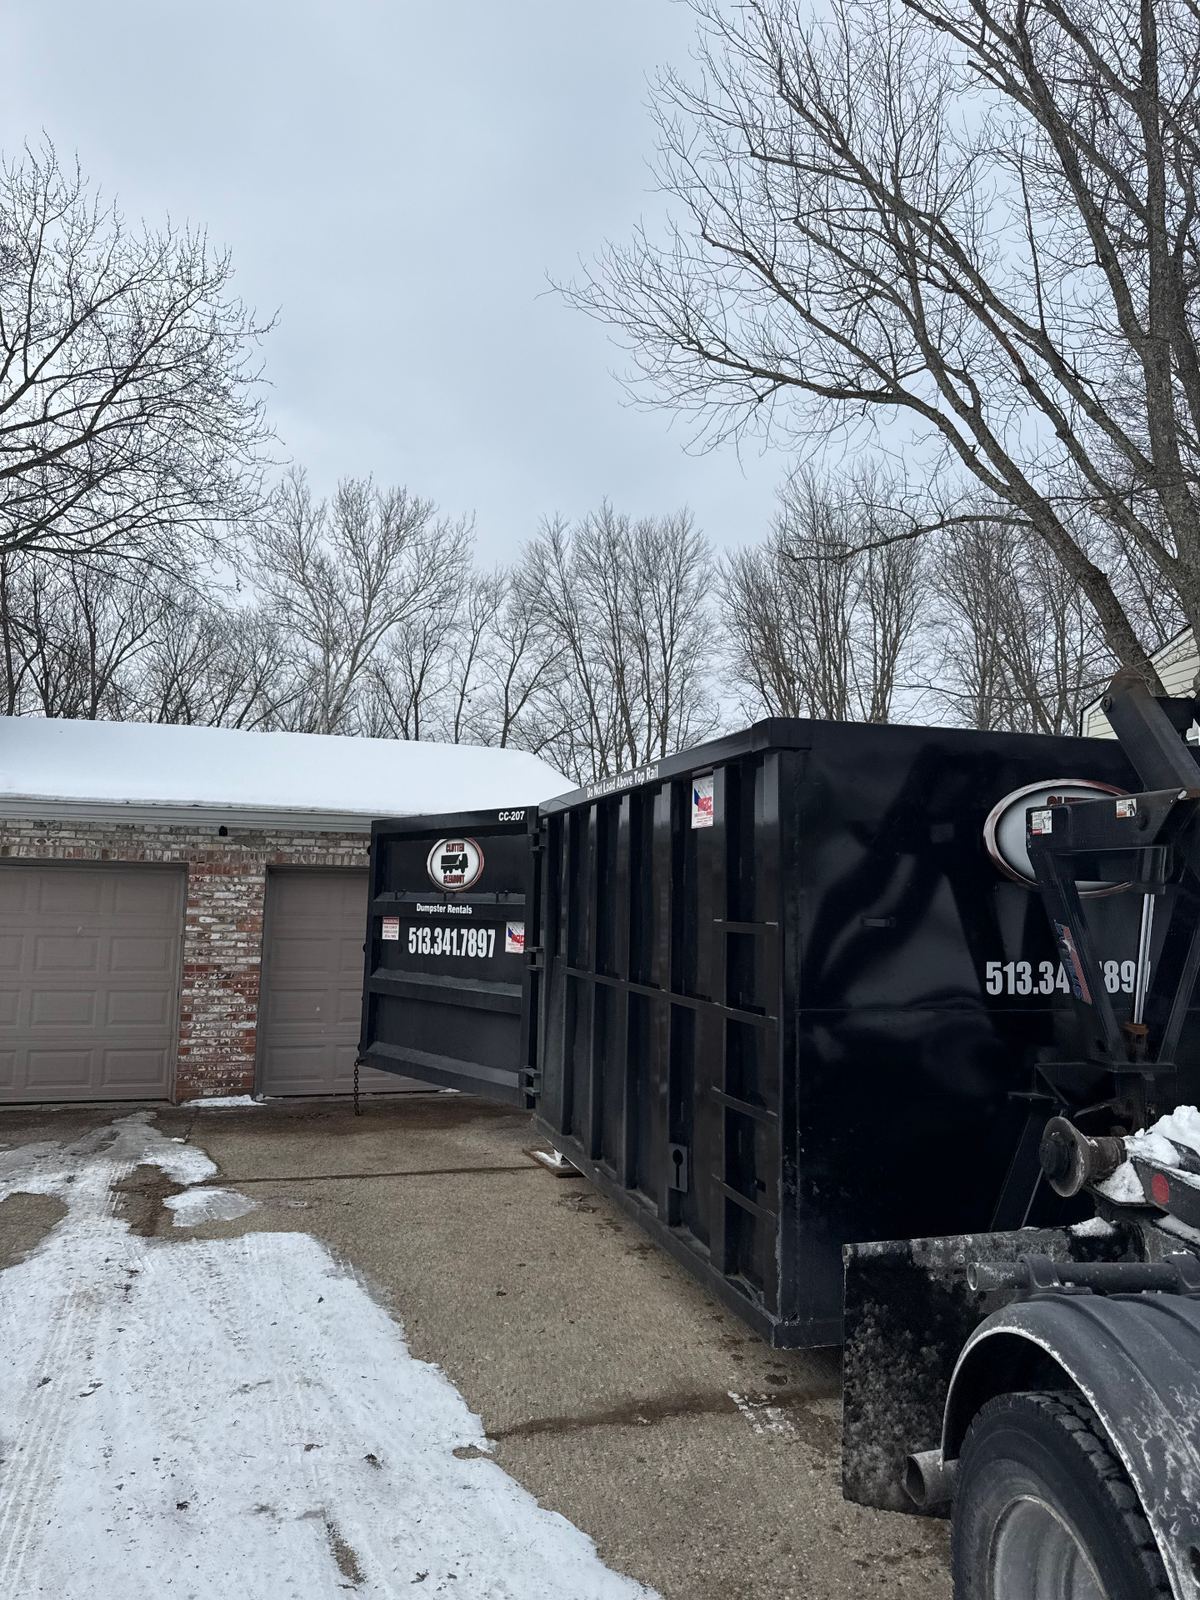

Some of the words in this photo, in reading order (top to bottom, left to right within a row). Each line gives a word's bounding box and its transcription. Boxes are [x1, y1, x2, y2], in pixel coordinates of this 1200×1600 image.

[586, 787, 593, 798] Do
[593, 783, 603, 796] Not
[602, 778, 616, 793] Load
[616, 775, 633, 789] Above
[633, 770, 645, 785] Top
[646, 764, 659, 780] Rail
[498, 810, 525, 821] CC-207
[416, 903, 446, 915] Dumpster
[447, 904, 473, 915] Rentals
[408, 927, 496, 958] 513.341.7897
